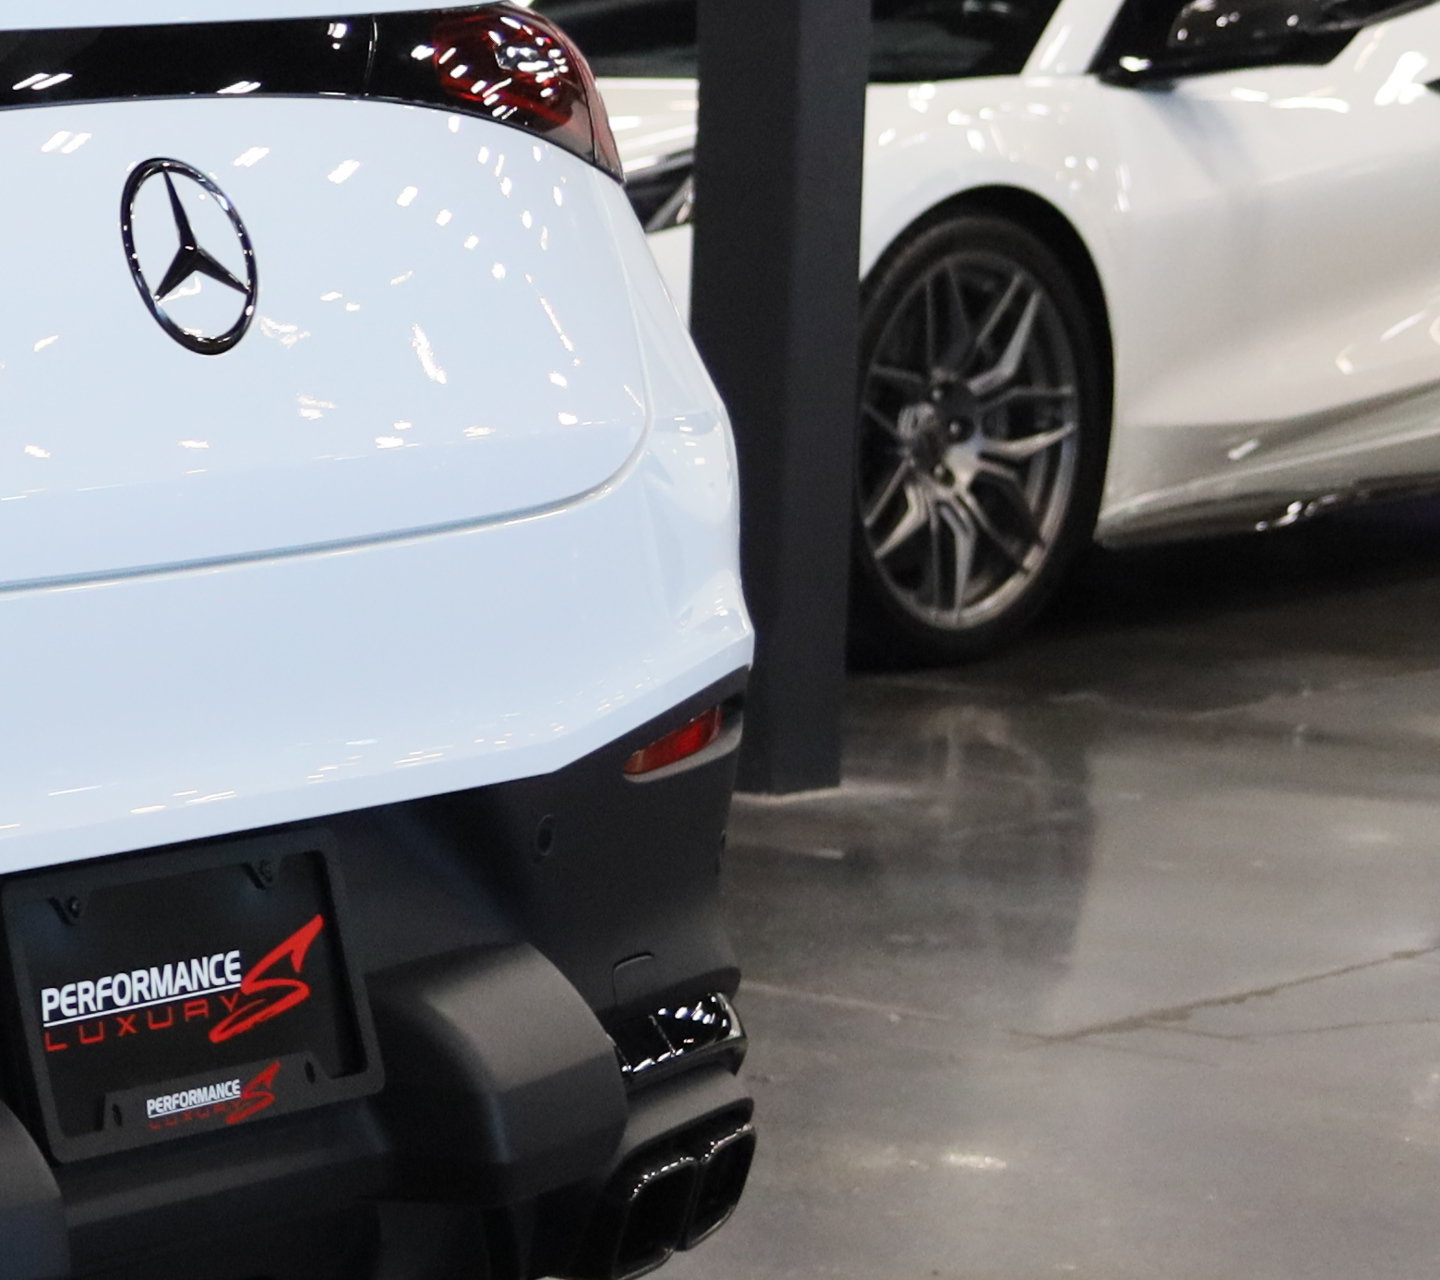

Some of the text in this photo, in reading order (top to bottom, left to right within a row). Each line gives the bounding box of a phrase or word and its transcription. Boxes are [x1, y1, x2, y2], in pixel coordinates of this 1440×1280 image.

[41, 949, 241, 1019] PERFORMANCE
[44, 994, 245, 1051] LUXURY
[146, 1080, 241, 1116] PERFORMANCE
